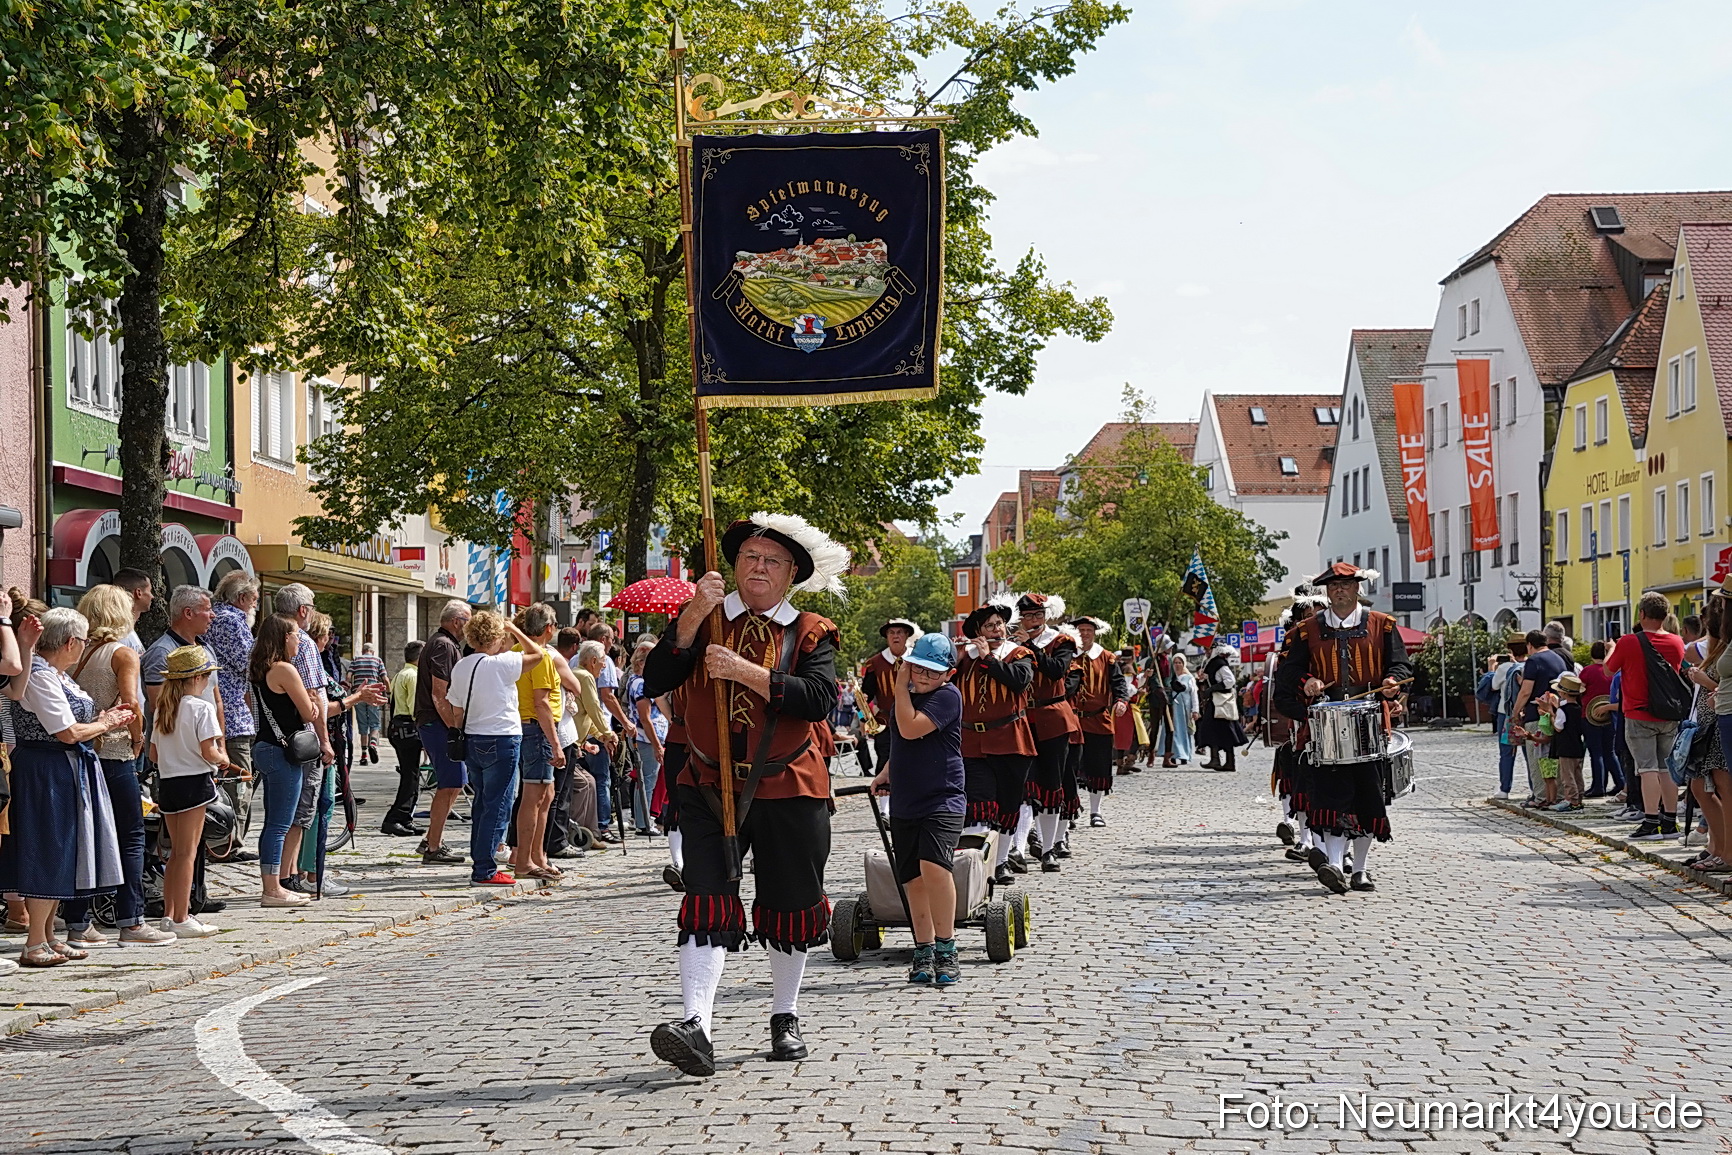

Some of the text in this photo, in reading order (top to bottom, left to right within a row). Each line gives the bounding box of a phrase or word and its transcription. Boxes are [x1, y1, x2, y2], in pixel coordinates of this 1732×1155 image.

[746, 178, 890, 223] Spielmannszug
[734, 294, 901, 343] Markt Lupburg
[1463, 411, 1493, 490] SALE
[1586, 466, 1641, 496] HOTEL Lehmeier
[1474, 533, 1501, 544] SCHMID
[403, 564, 421, 572] family
